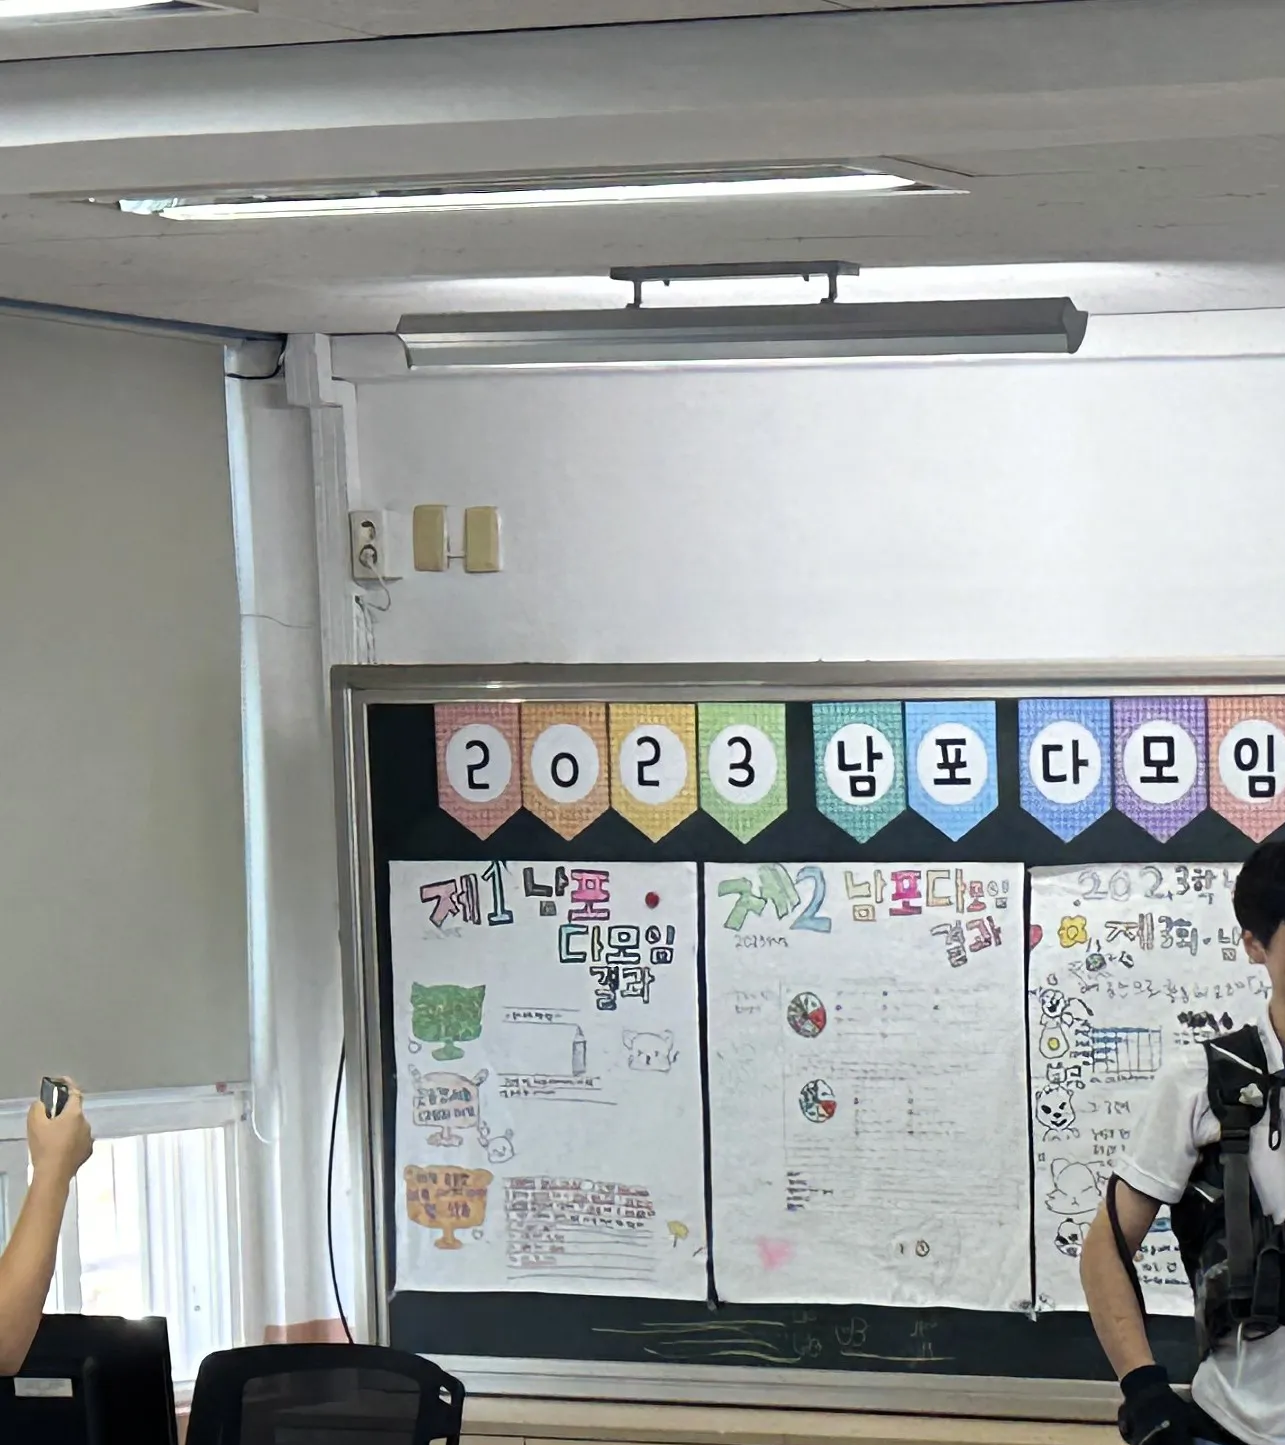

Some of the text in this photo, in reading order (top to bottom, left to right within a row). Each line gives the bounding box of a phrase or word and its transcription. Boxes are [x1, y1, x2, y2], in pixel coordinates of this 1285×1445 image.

[465, 734, 1276, 798] 2023 남포 다모임
[420, 861, 610, 928] 제1 남포
[558, 923, 676, 965] 다모임
[590, 965, 655, 1011] 결과
